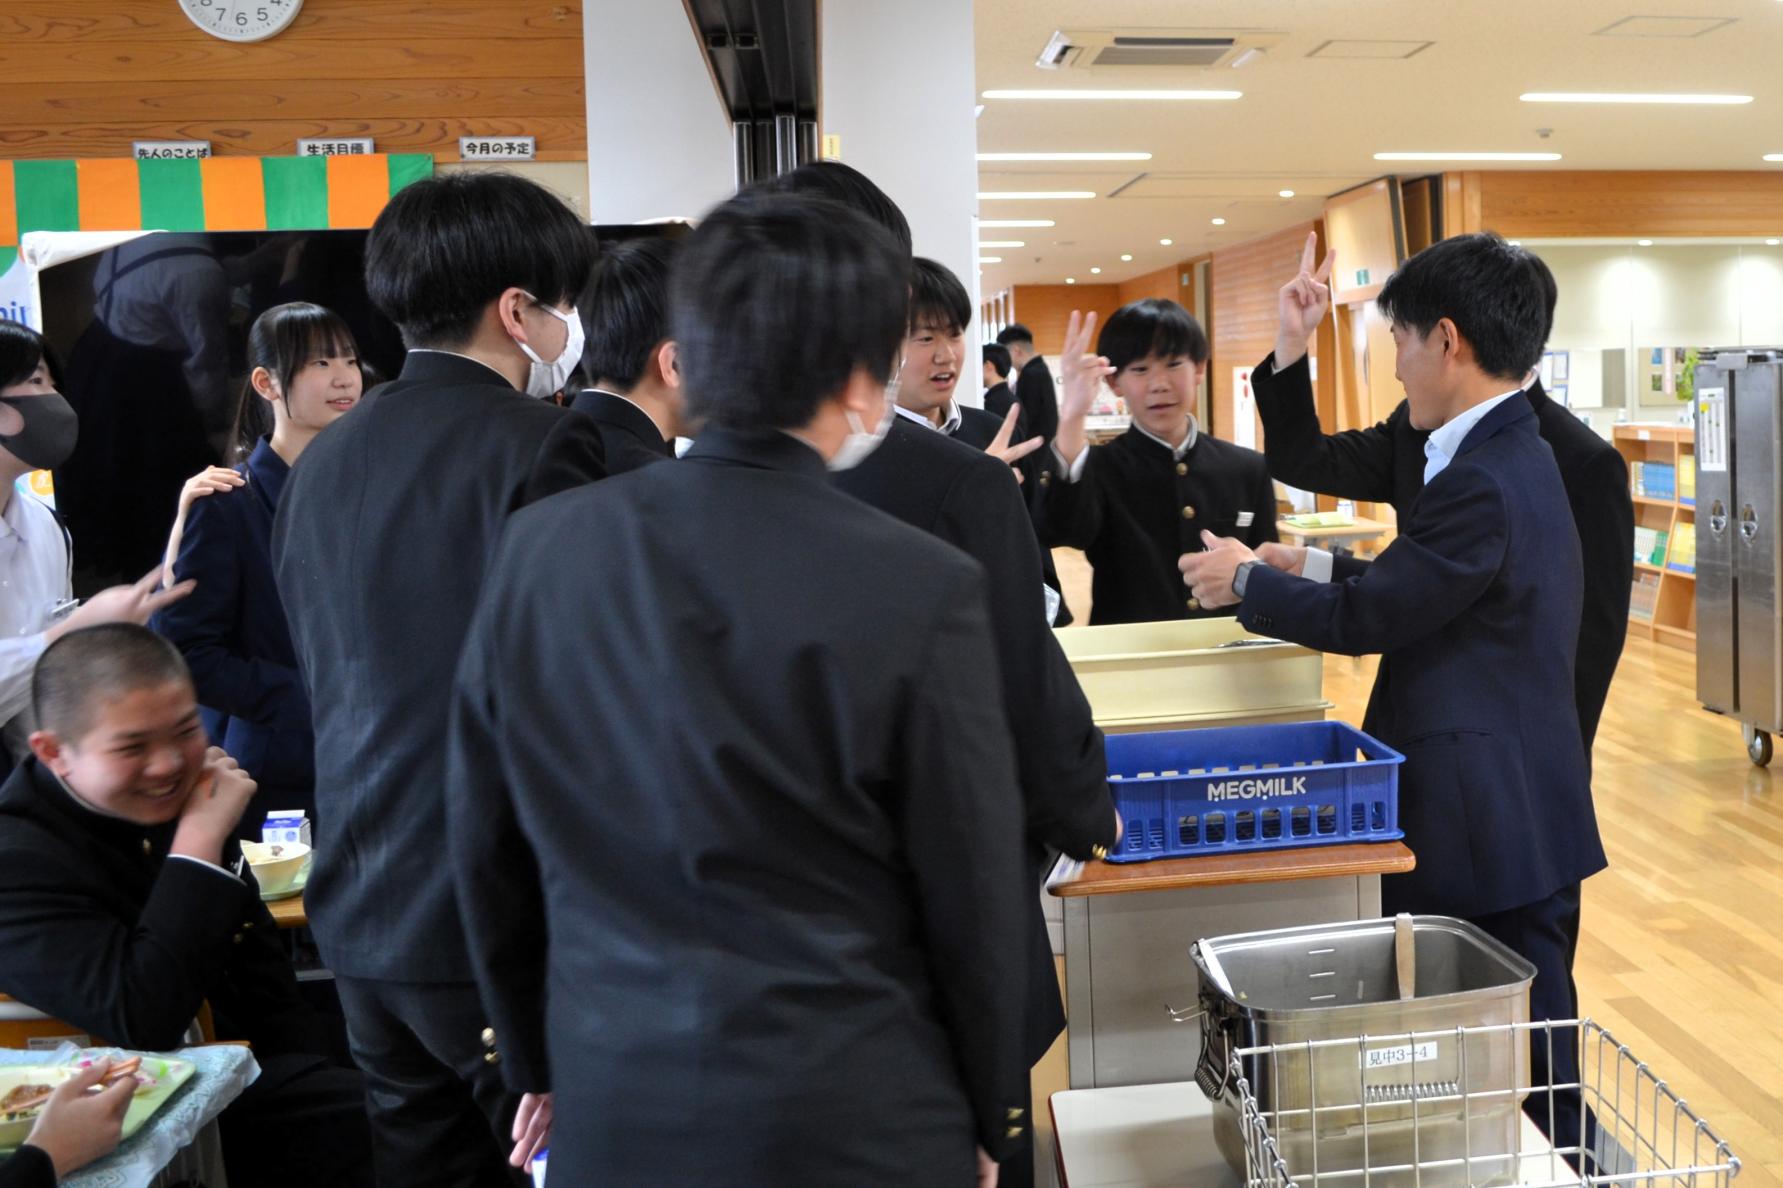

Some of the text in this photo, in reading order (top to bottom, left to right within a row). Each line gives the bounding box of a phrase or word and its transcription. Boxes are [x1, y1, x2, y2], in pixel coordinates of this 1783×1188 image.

[215, 8, 226, 21] 7
[236, 12, 247, 26] 6
[257, 8, 268, 21] 5
[466, 142, 530, 155] 今月の予定
[1207, 776, 1306, 801] MEGMILK
